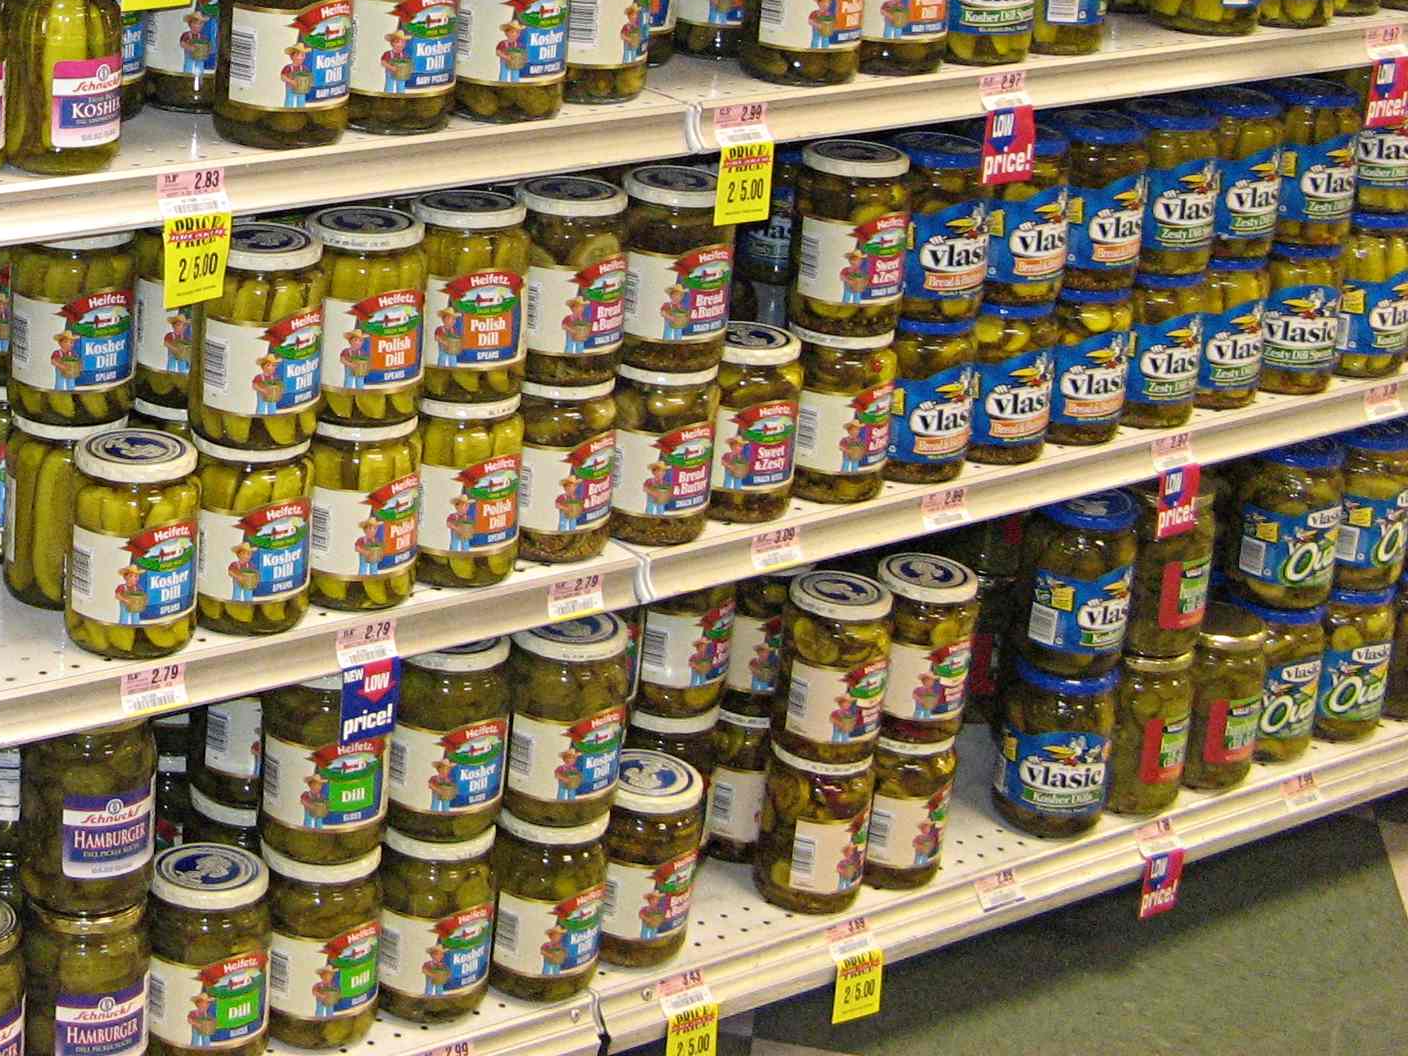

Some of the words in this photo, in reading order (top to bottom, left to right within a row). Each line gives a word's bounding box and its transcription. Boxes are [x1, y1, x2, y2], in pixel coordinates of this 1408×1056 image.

[530, 32, 564, 48] Kosher
[416, 42, 452, 59] Kosher
[539, 45, 557, 60] Dill
[426, 56, 445, 73] Dill
[992, 112, 1013, 138] LOW
[984, 145, 1032, 180] price!
[194, 170, 219, 189] 2.83
[470, 317, 506, 334] Polish
[478, 332, 499, 346] Dill
[85, 339, 125, 357] Kosher
[96, 354, 117, 368] Dill
[756, 445, 786, 460] Sweet
[365, 622, 390, 640] 2.79
[343, 670, 363, 684] NEW
[364, 673, 389, 693] LOW
[343, 706, 393, 741] price!
[460, 763, 496, 780] Kosher
[342, 788, 365, 803] Dill
